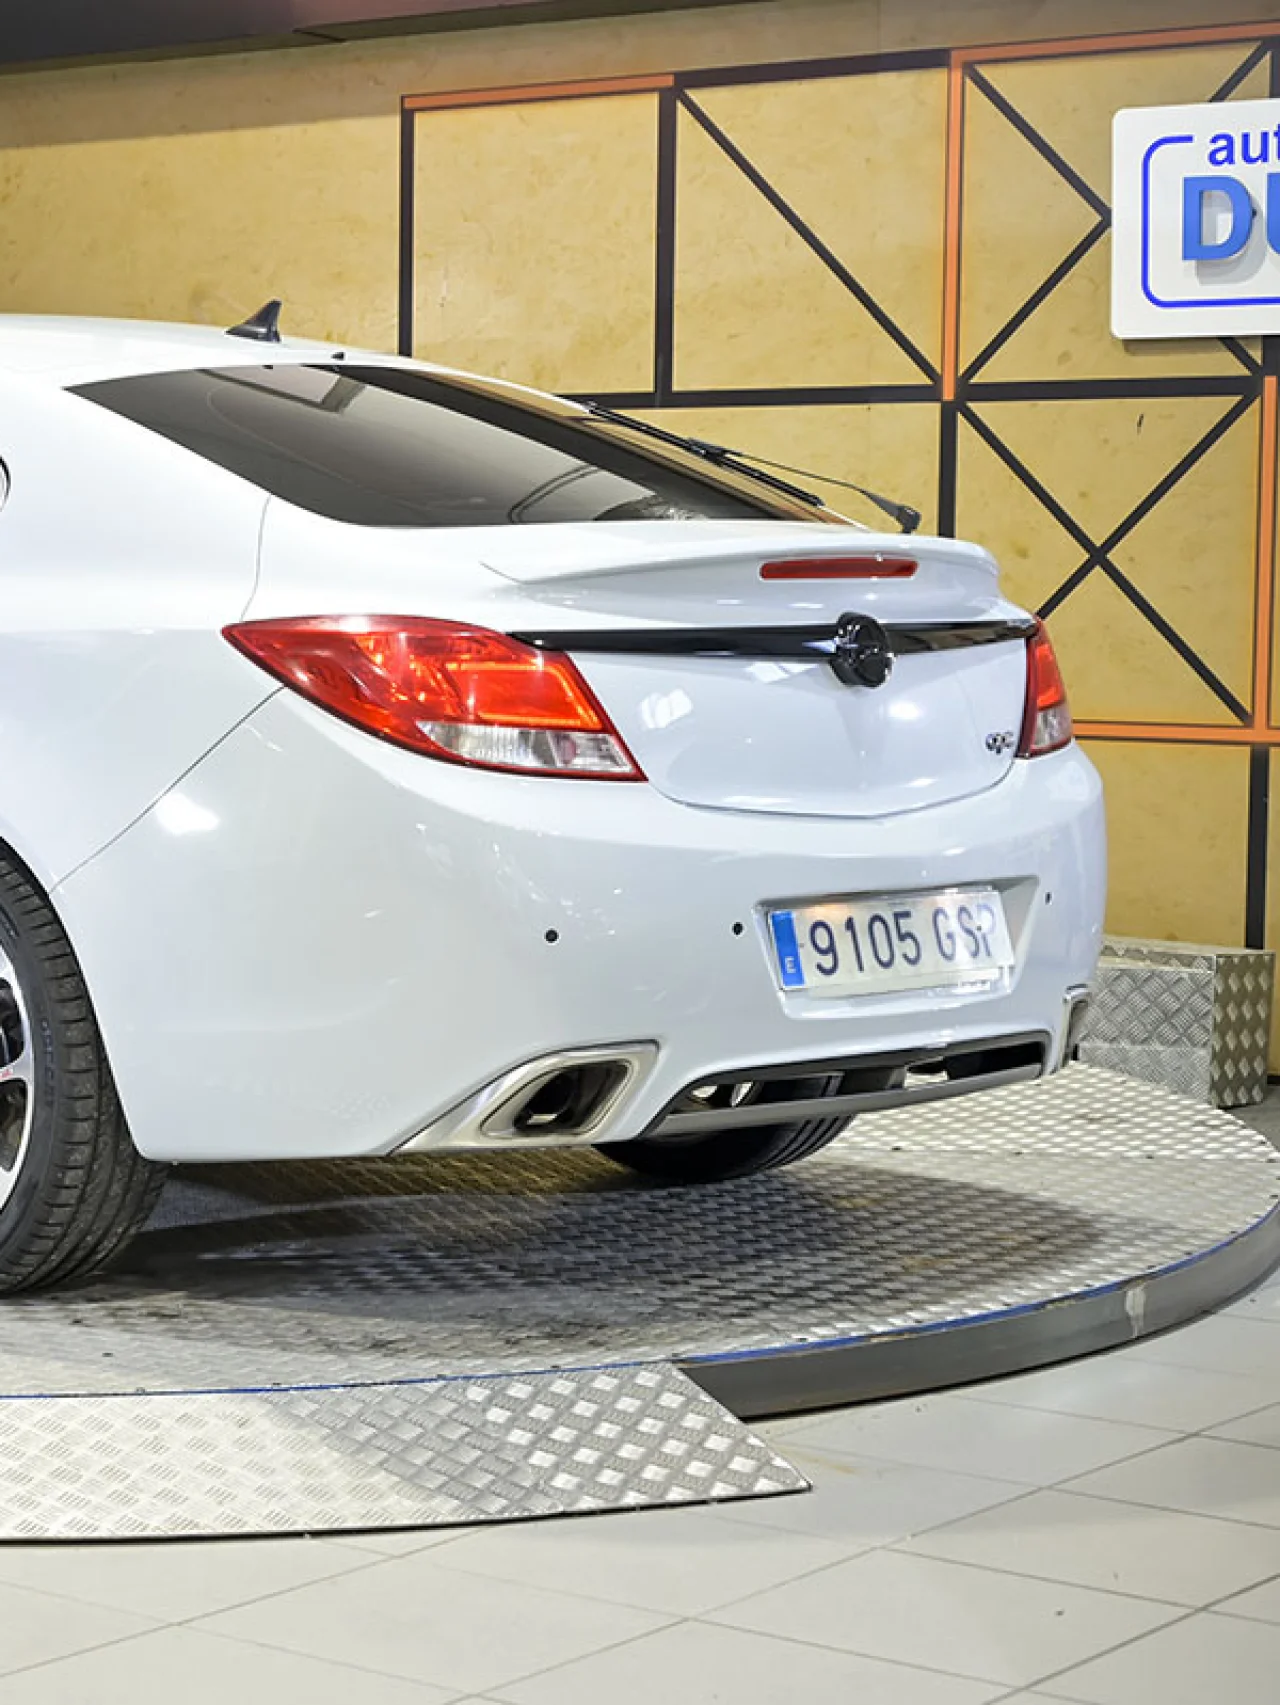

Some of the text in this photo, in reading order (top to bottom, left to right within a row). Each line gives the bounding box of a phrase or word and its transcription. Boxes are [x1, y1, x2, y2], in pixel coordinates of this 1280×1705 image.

[1181, 171, 1280, 262] D
[784, 956, 796, 973] E
[809, 903, 996, 976] 9105 GSP
